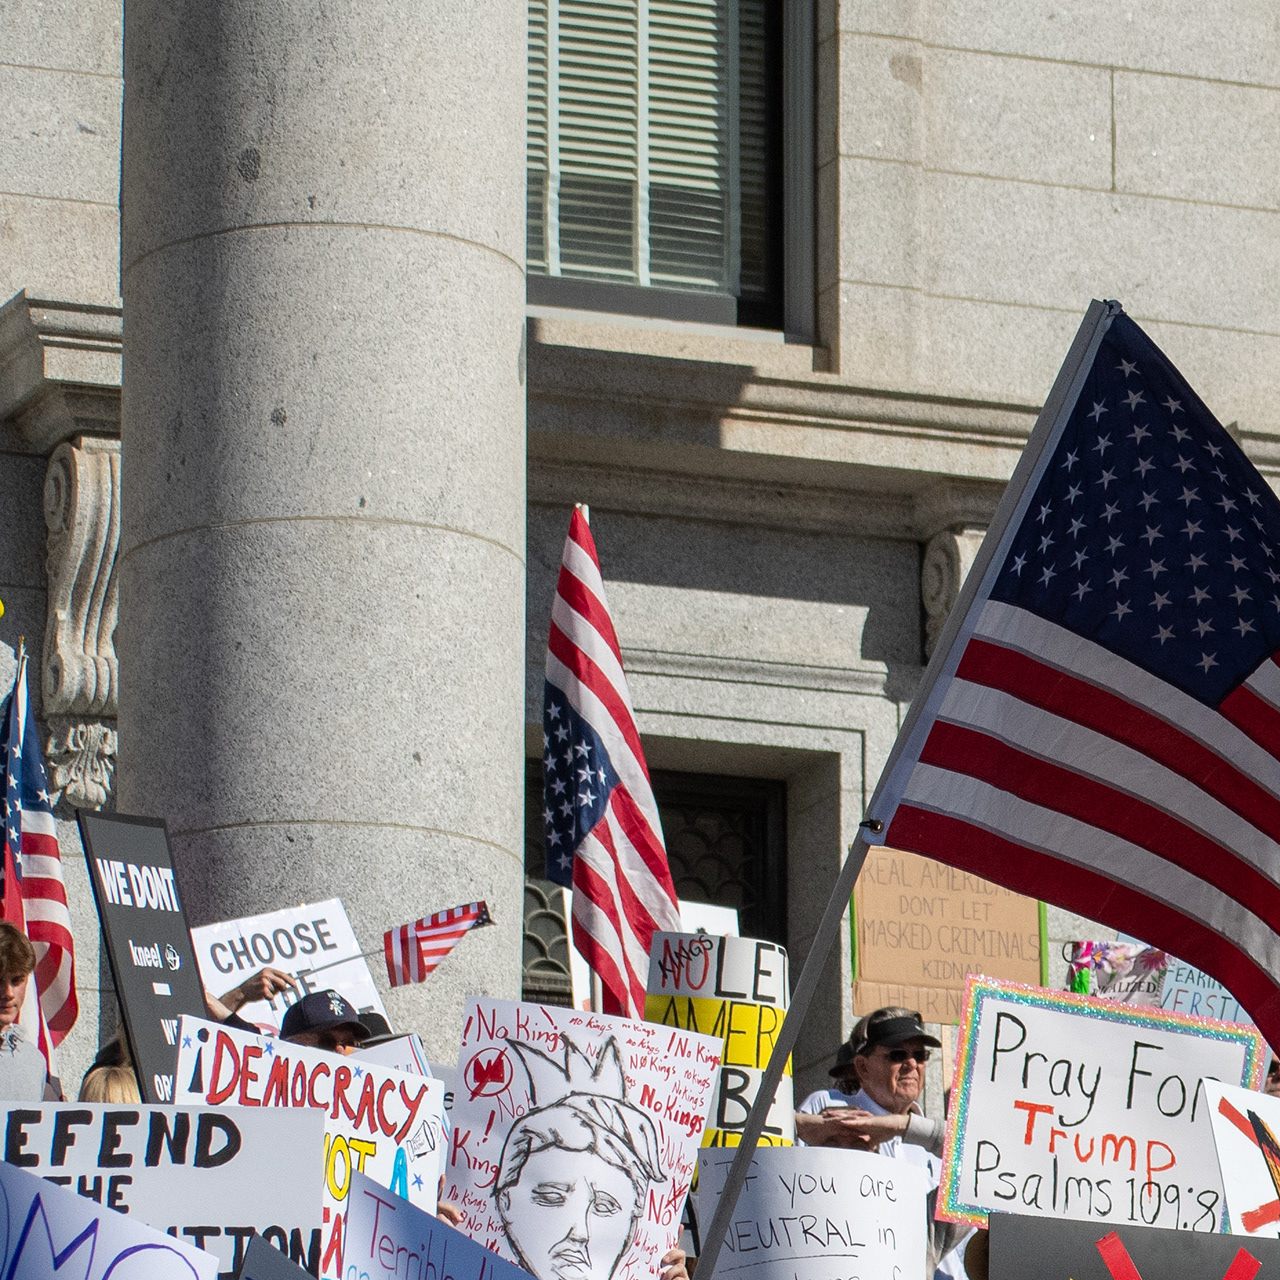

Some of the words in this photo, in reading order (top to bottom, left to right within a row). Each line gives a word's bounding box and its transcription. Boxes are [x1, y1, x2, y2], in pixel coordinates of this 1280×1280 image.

[97, 858, 132, 905] WE
[128, 864, 180, 912] DONT
[962, 901, 993, 921] LET
[209, 918, 338, 974] CHOOSE
[862, 918, 932, 951] MASKED
[938, 925, 1040, 961] CRIMINALS
[990, 1011, 1103, 1128] Pray
[973, 1139, 1114, 1217] Psalms
[1013, 1099, 1177, 1205] Trump
[779, 1173, 838, 1209] you
[859, 1174, 897, 1202] are
[878, 1219, 895, 1250] in
